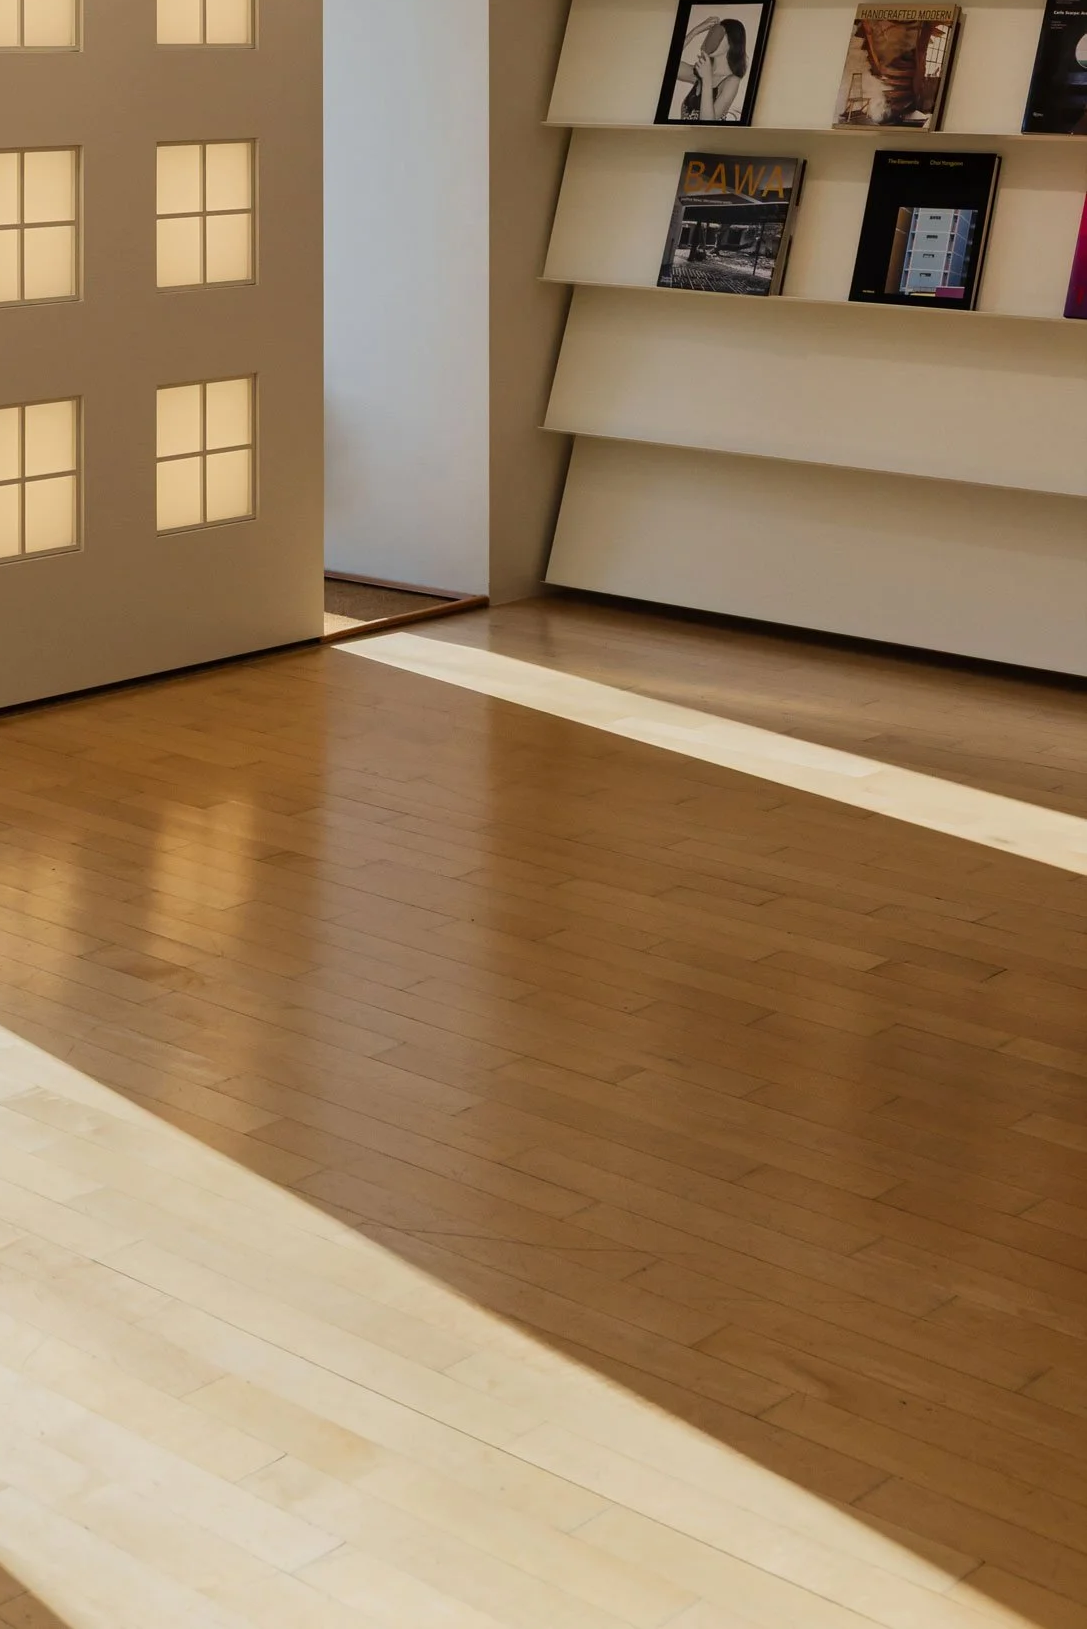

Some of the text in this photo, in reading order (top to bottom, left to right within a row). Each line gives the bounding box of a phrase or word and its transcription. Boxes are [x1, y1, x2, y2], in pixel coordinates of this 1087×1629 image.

[860, 9, 952, 20] HANDCRAFTED MODERN
[683, 160, 786, 199] BAWA
